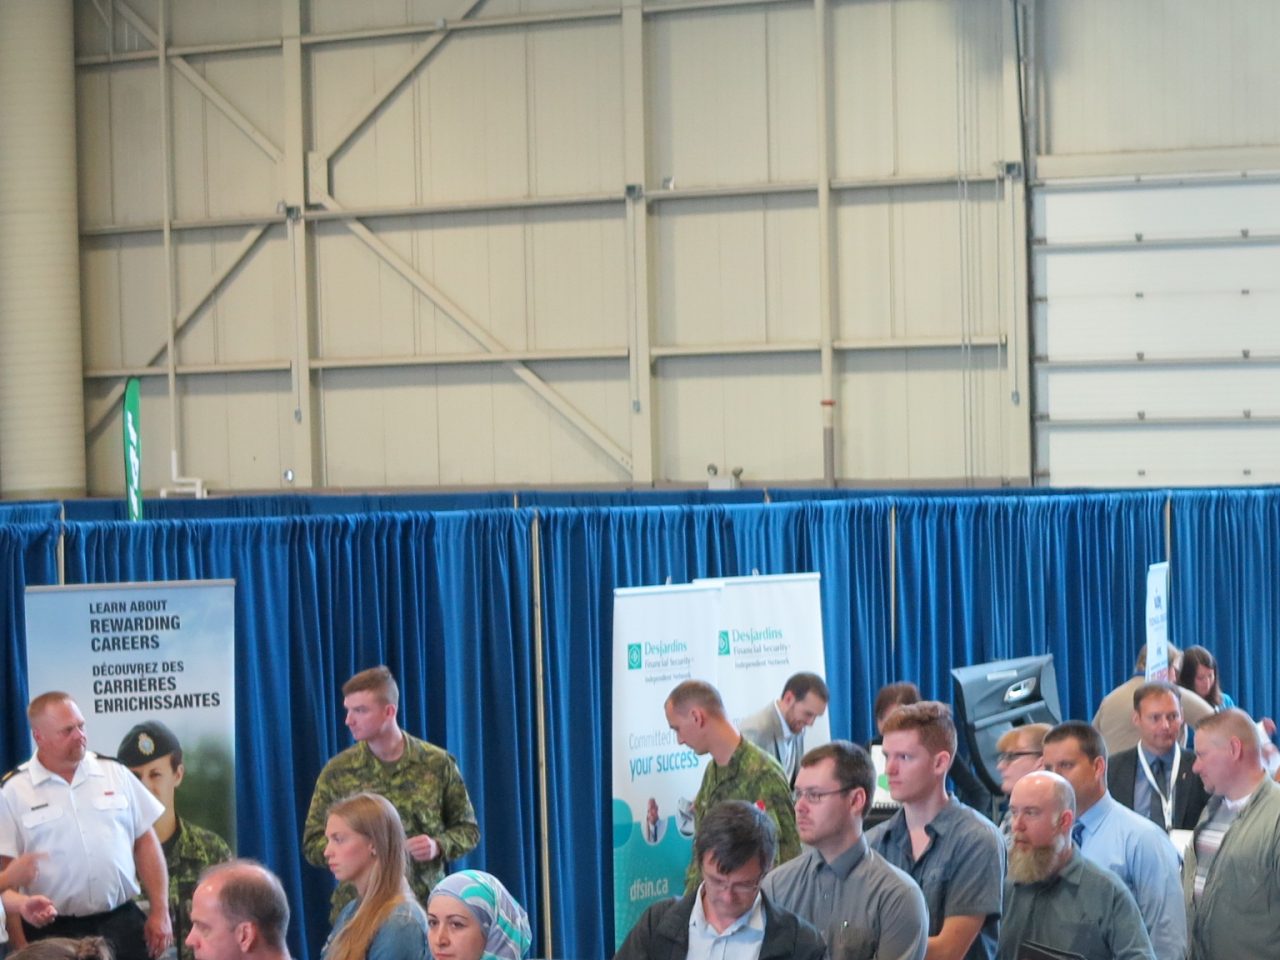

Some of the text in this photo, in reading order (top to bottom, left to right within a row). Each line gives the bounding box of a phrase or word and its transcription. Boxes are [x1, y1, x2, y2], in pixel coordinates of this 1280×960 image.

[89, 600, 167, 614] LEARN ABOUT
[90, 615, 180, 634] REWARDING
[732, 626, 783, 643] Desjardins
[91, 635, 160, 652] CAREERS
[644, 639, 688, 656] Desjardins
[734, 645, 762, 656] Financial
[92, 660, 184, 677] DÉCOUVREZ DES
[645, 657, 669, 668] Financial
[735, 657, 790, 670] Independent Network
[93, 674, 177, 695] CARRIÈRES
[94, 692, 220, 714] ENRICHISSANTES
[628, 729, 671, 748] Committed
[629, 750, 700, 782] your success
[630, 878, 669, 902] dfsin.ca
